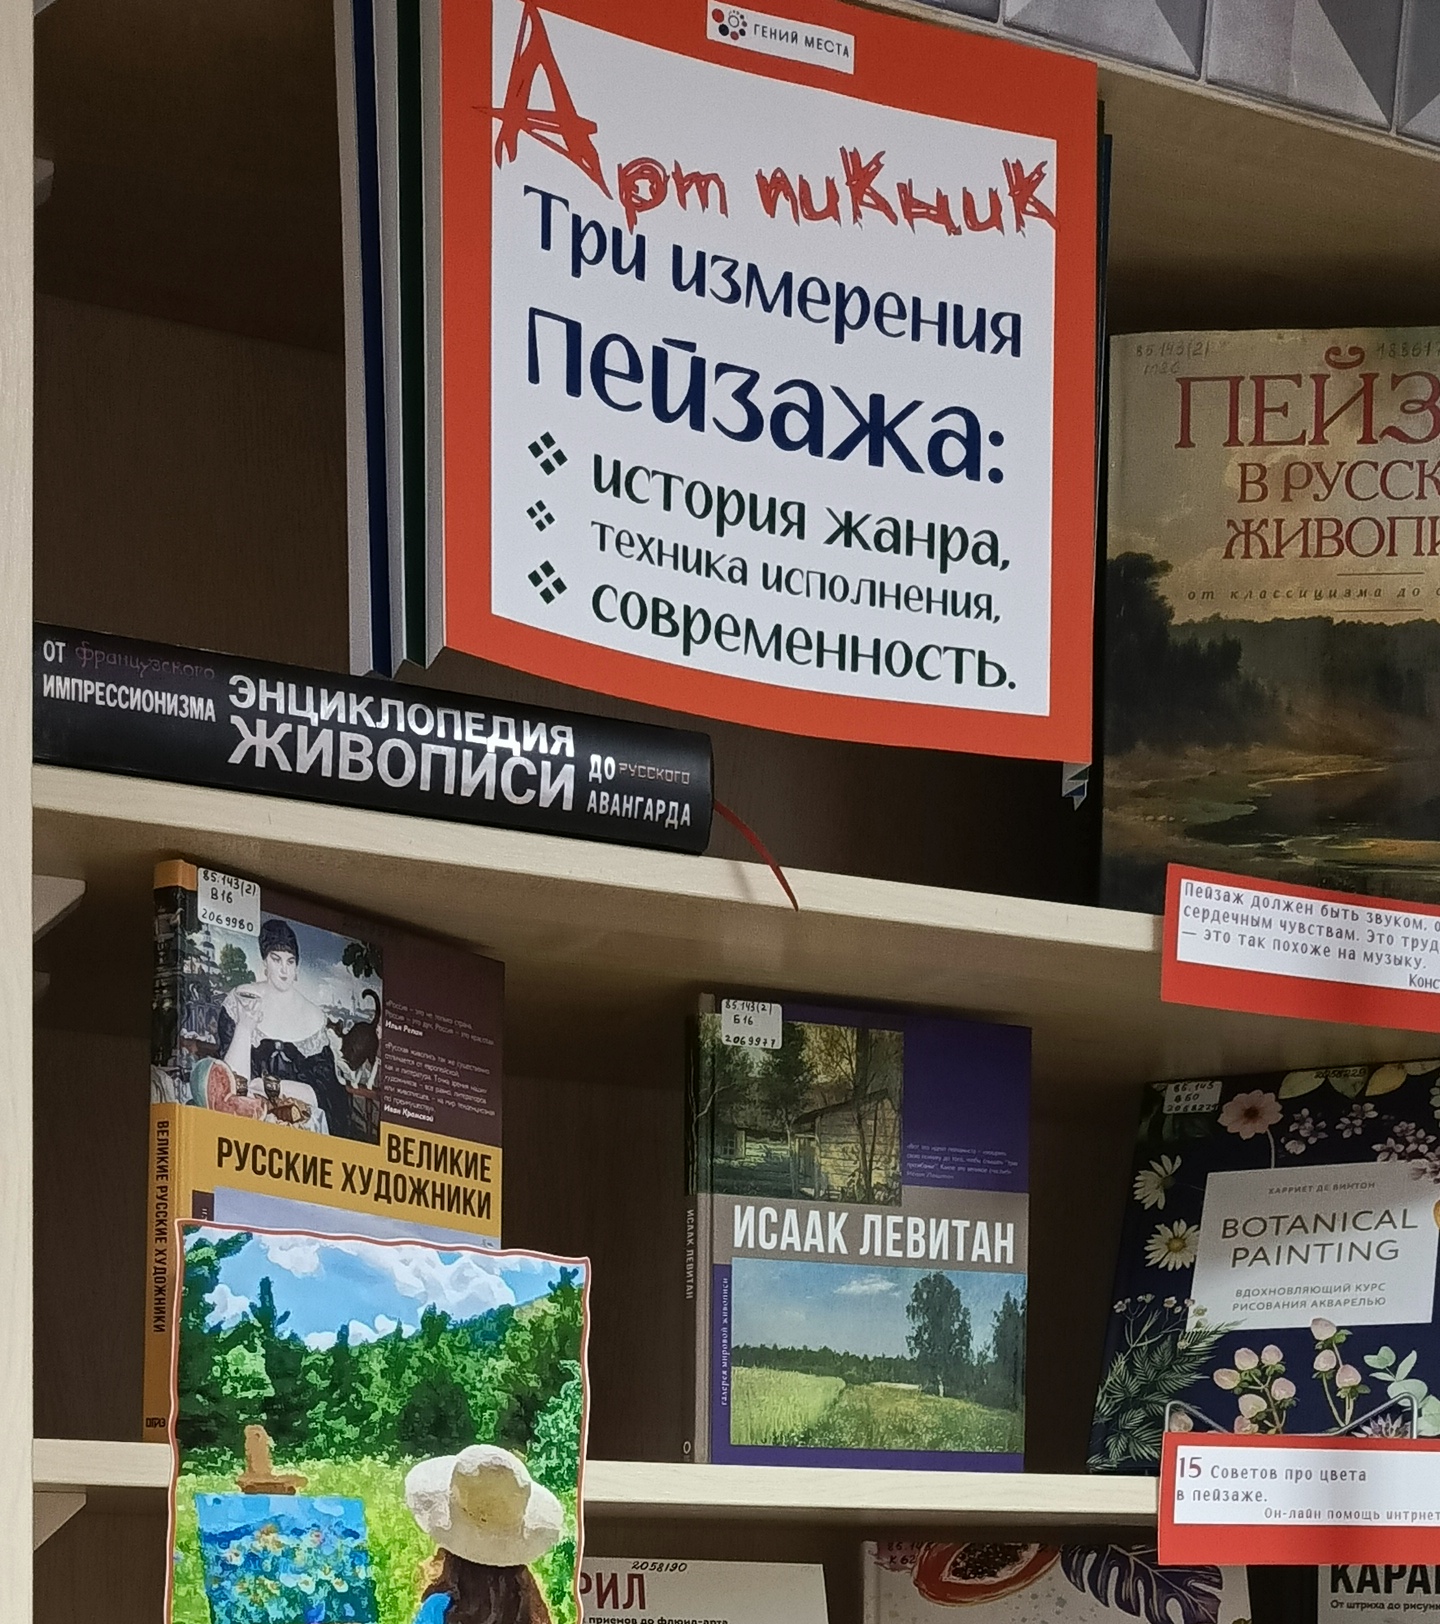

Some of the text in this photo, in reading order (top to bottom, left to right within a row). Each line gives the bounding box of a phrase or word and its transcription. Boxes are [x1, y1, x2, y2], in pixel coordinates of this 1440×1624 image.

[753, 21, 851, 58] ГЕНИЙ МЕСТА
[472, 0, 729, 233] Арт
[524, 185, 1022, 358] Три измерения
[1237, 462, 1269, 503] В
[592, 454, 1011, 574] история жанра,
[592, 520, 1001, 625] техника исполнения,
[1188, 590, 1215, 601] от
[1230, 587, 1382, 601] классицизма
[43, 639, 66, 663] ОТ
[592, 582, 1018, 691] современность.
[43, 674, 217, 723] ИМПРЕССИОНИЗМА
[229, 675, 574, 757] ЭНЦИКЛОПЕДИЯ
[228, 714, 574, 811] ЖИВОПИСИ
[589, 754, 615, 783] ДО
[587, 789, 691, 830] АВАНГАРДА
[1185, 882, 1244, 905] Пейзаж
[1250, 895, 1313, 915] должен
[1321, 901, 1359, 922] быть
[1183, 905, 1440, 954] сердечным чувствам. Это труд
[1203, 929, 1427, 970] это так похоже на музыку.
[217, 1136, 492, 1220] РУССКИЕ ХУДОЖНИКИ
[387, 1133, 492, 1183] ВЕЛИКИЕ
[1269, 1185, 1313, 1195] ХАРРИЕТ
[152, 1120, 170, 1333] ВЕЛИКИЕ РУССКИЕ ХУДОЖНИКИ
[734, 1205, 1015, 1264] ИСААК ЛЕВИТАН
[1221, 1208, 1418, 1239] BOTANICAL
[1231, 1239, 1399, 1268] PAINTING
[1232, 1297, 1386, 1311] РИСОВАНИЯ АКВАРЕЛЬЮ
[1235, 1283, 1386, 1298] ВДОХНОВЛЯЮЩИЙ КУРС
[1178, 1456, 1367, 1482] 15 Советов про цвета
[1177, 1489, 1268, 1502] в пейзаже.
[1264, 1507, 1321, 1519] Он-лайн
[1327, 1508, 1380, 1520] помощь
[1331, 1564, 1440, 1594] КАРА
[1330, 1600, 1400, 1612] От штриха до
